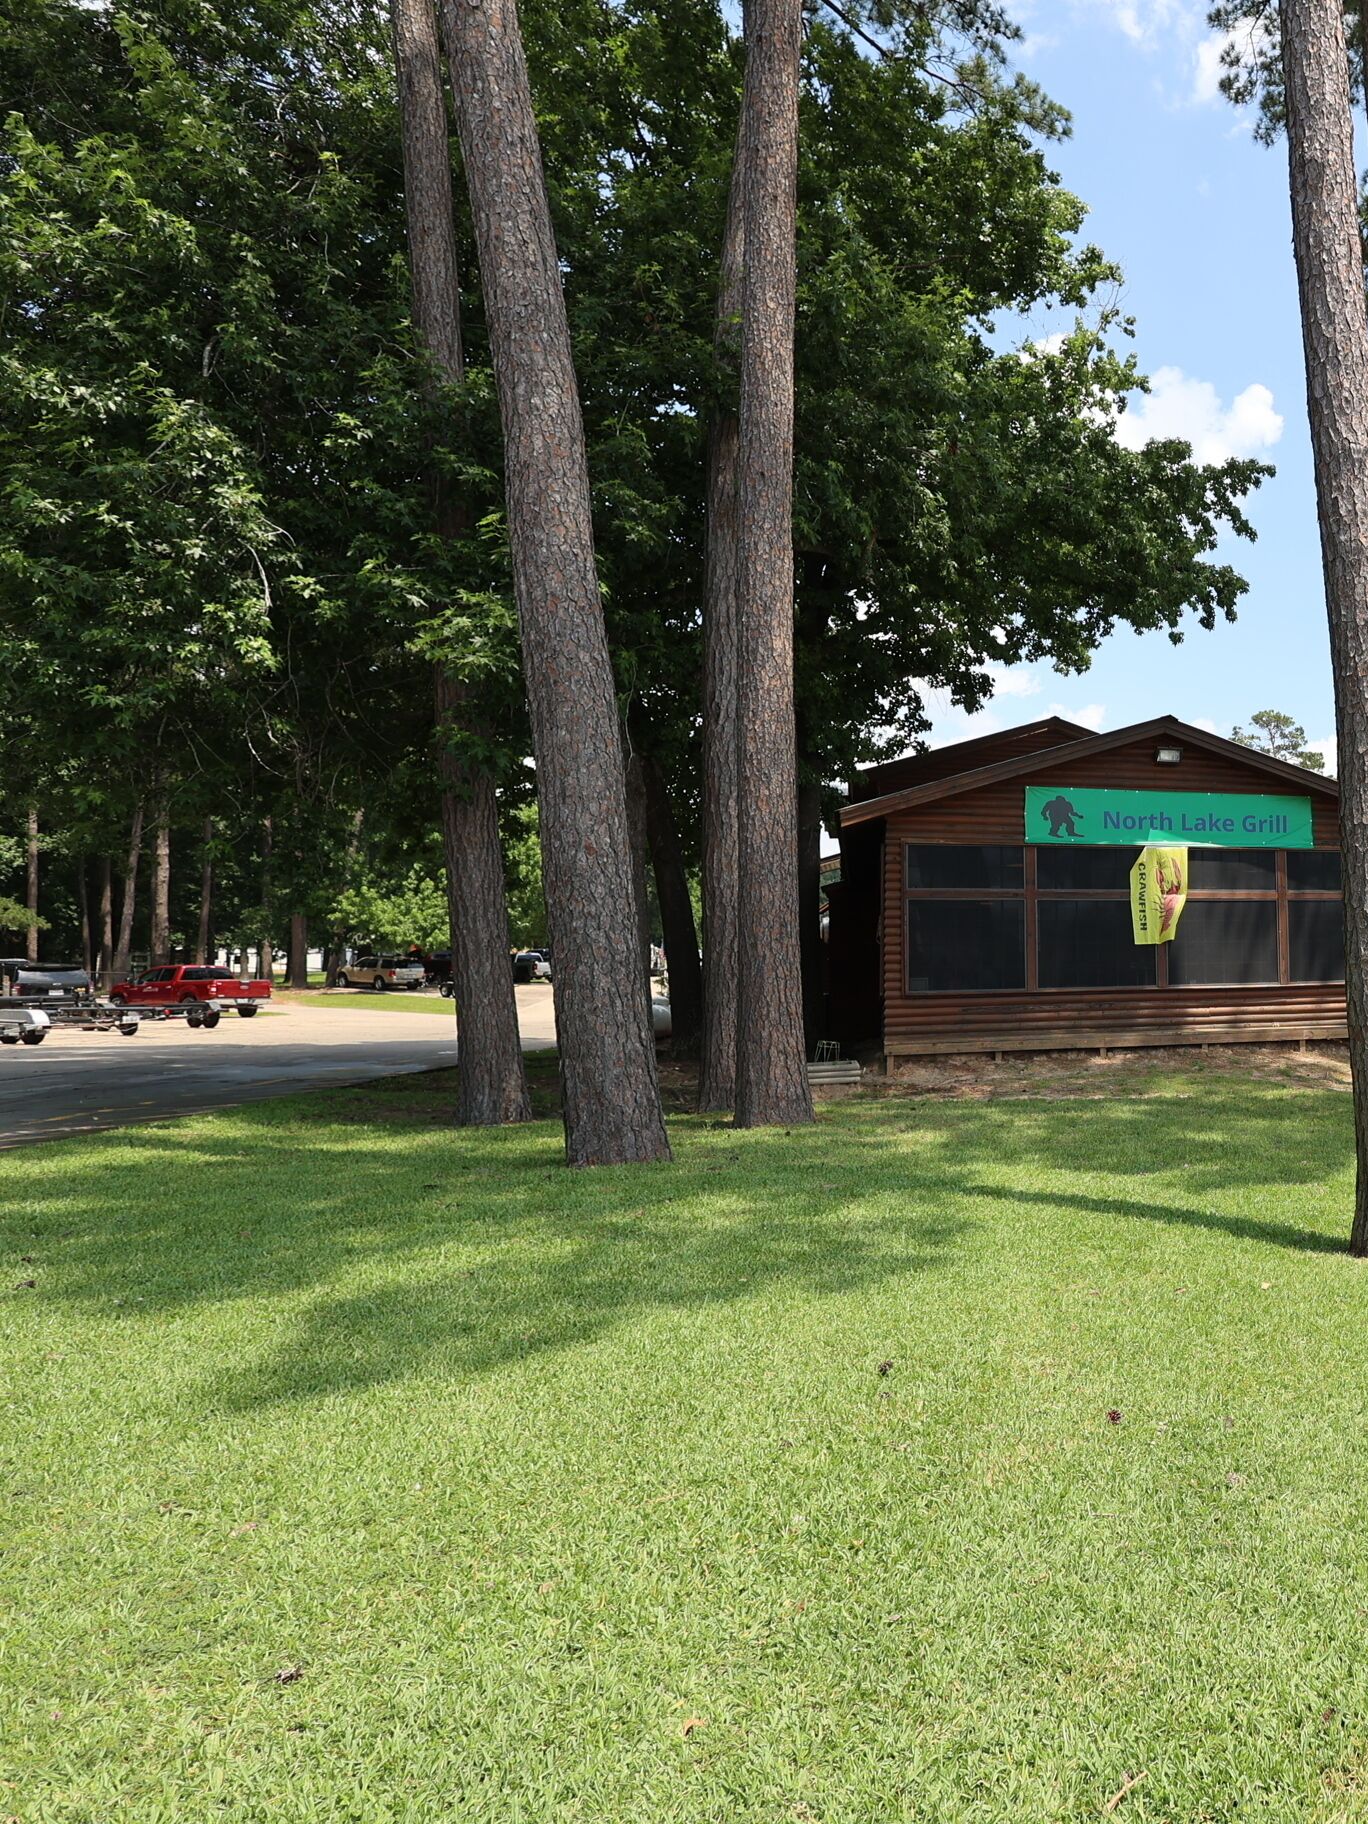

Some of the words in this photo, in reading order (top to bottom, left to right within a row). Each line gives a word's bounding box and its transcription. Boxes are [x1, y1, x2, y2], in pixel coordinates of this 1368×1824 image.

[1103, 811, 1173, 830] North
[1181, 813, 1235, 832] Lake
[1242, 815, 1288, 833] Grill
[1138, 862, 1148, 931] CRAWFISH
